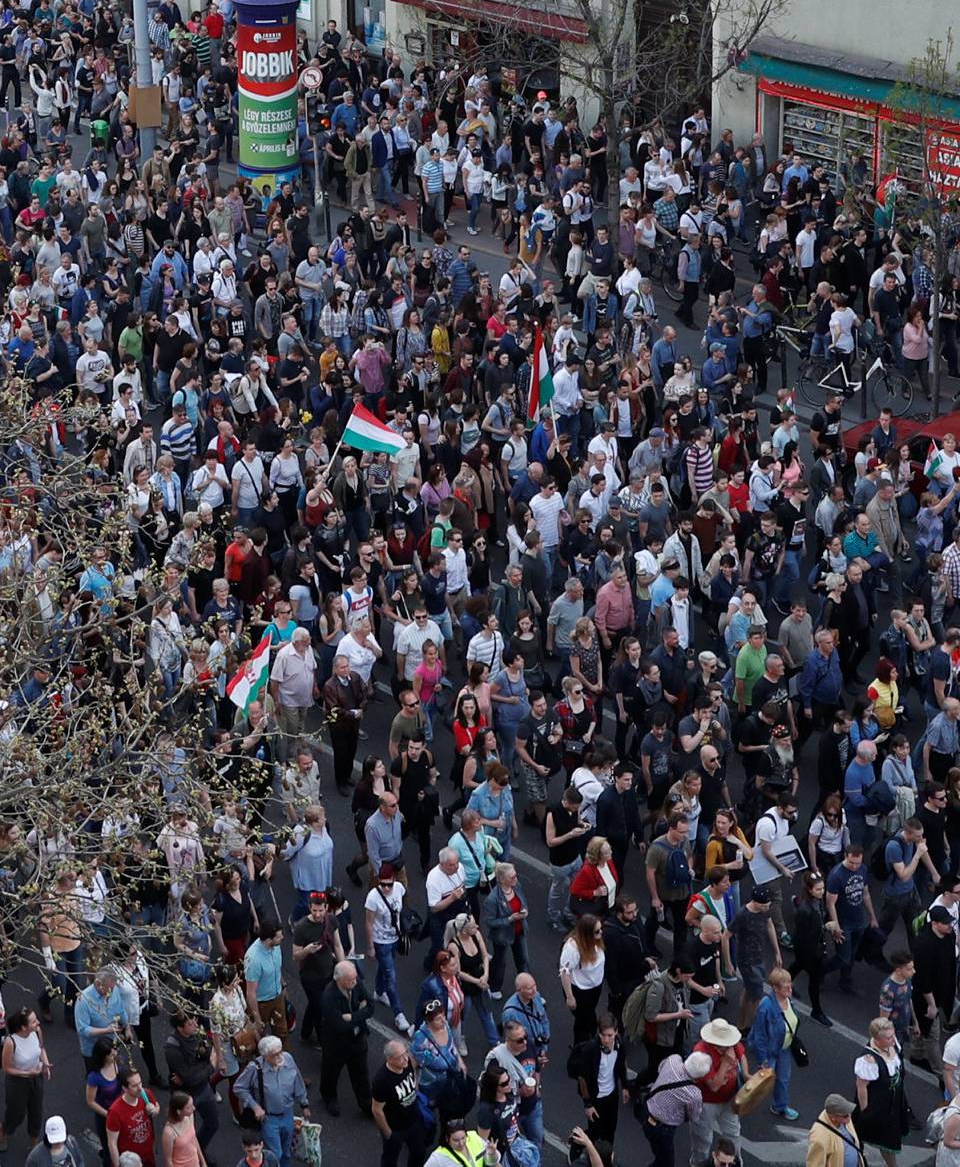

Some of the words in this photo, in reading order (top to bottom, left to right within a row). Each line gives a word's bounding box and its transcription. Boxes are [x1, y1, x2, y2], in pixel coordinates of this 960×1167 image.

[241, 49, 295, 77] JOBBIK
[243, 108, 259, 121] LÉGY
[261, 108, 292, 123] RÉSZESE
[242, 120, 246, 130] A
[259, 143, 281, 153] ÁPRILIS
